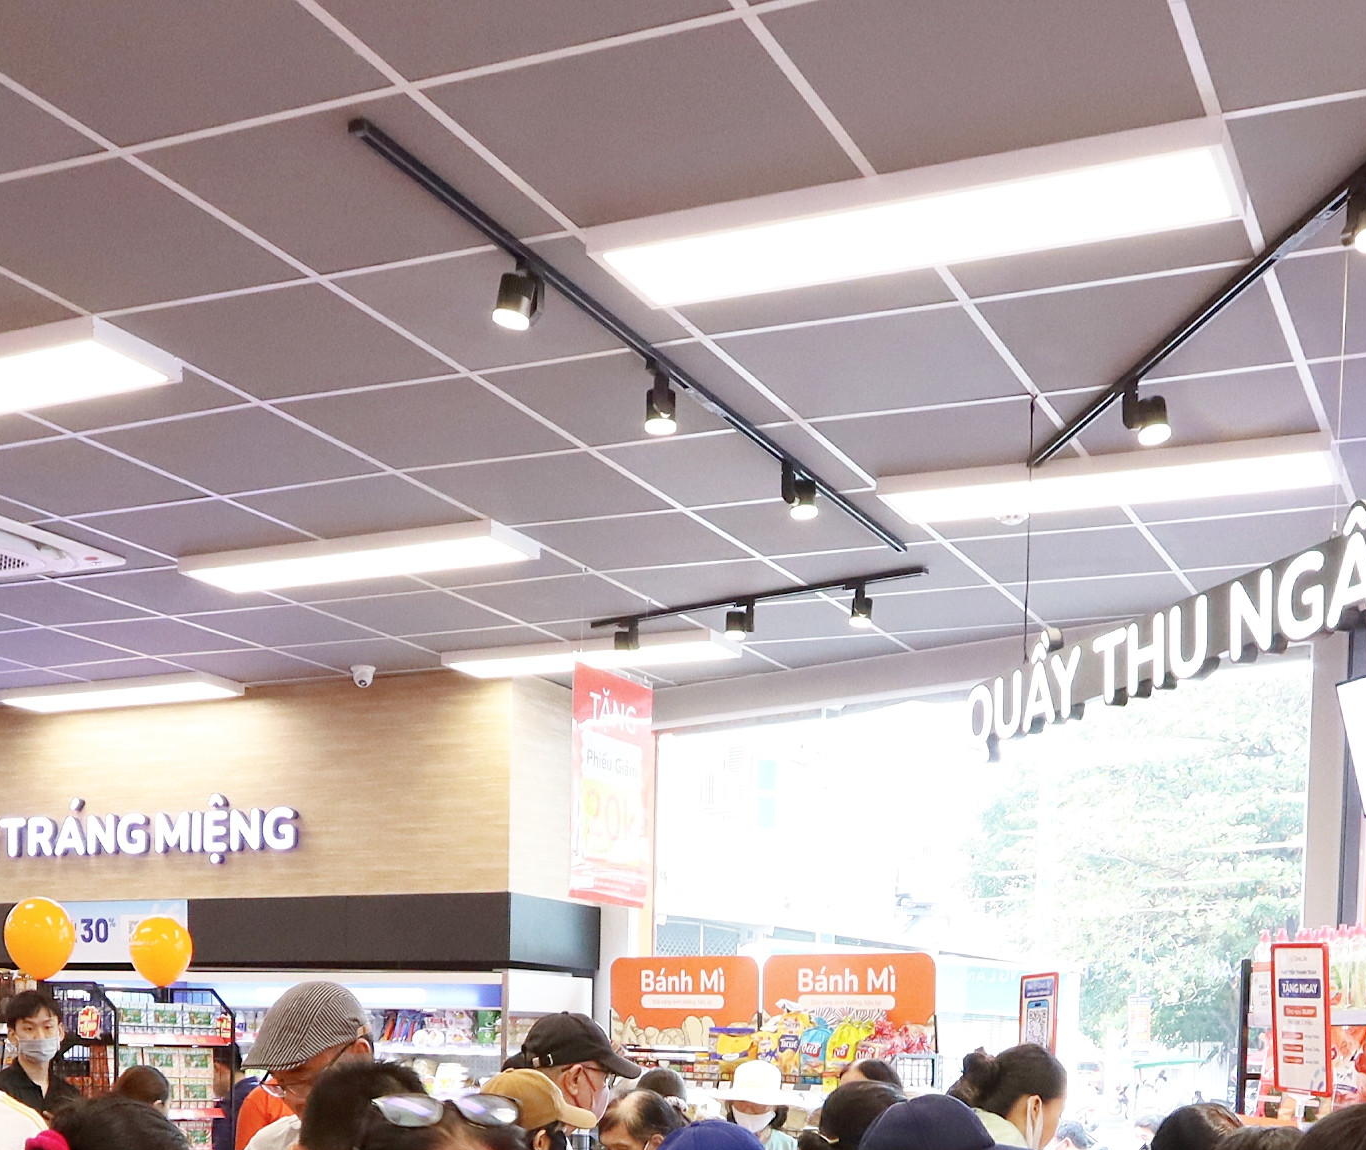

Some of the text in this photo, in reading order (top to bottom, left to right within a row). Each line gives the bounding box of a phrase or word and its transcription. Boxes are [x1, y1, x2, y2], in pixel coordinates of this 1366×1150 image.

[1092, 593, 1207, 705] THU
[153, 792, 300, 865] MIỆNG
[640, 967, 725, 993] Bánh Mì
[797, 964, 896, 993] Bánh Mì
